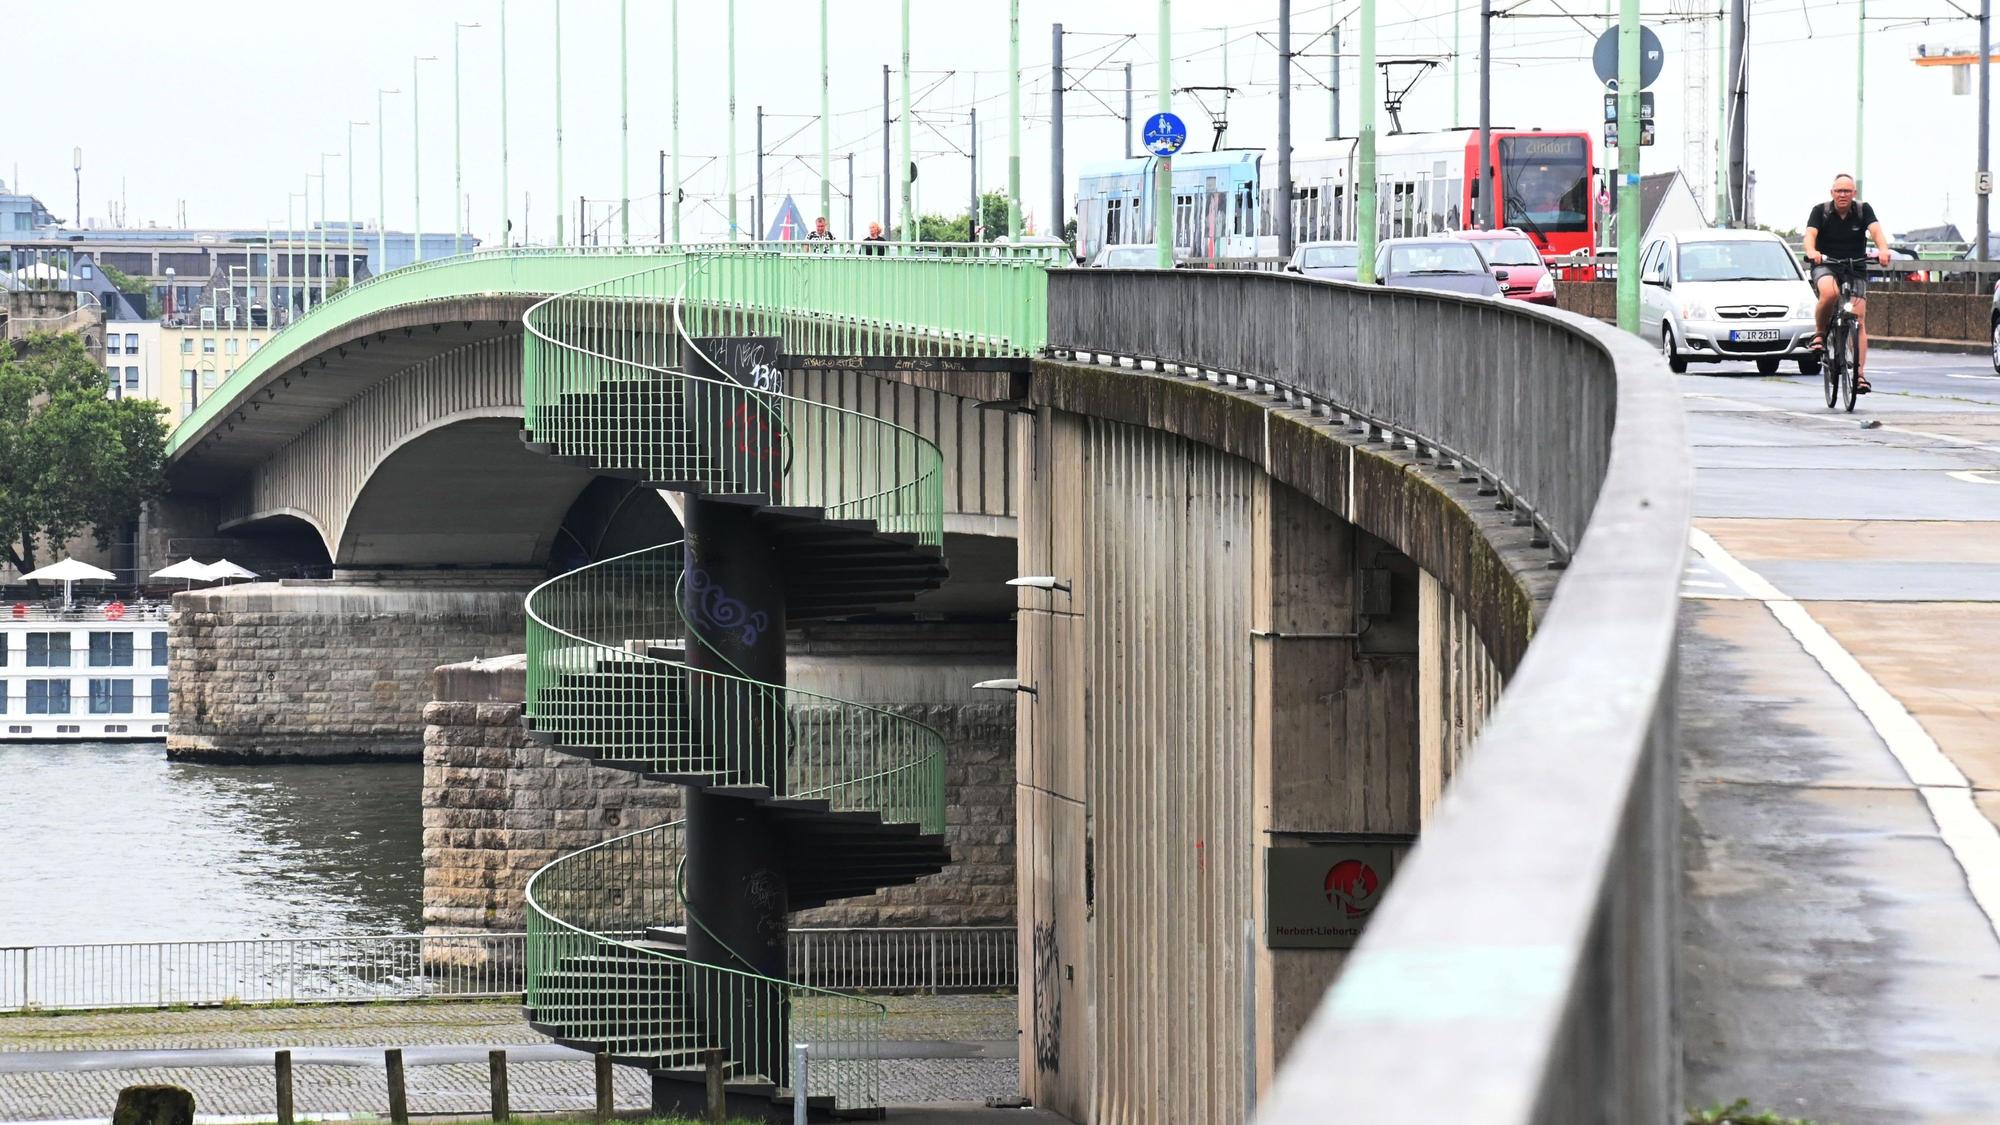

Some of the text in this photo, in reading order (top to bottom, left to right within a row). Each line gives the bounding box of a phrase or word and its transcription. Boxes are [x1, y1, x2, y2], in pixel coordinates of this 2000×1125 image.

[1979, 174, 1989, 192] 5
[1735, 331, 1778, 340] K IR 2811
